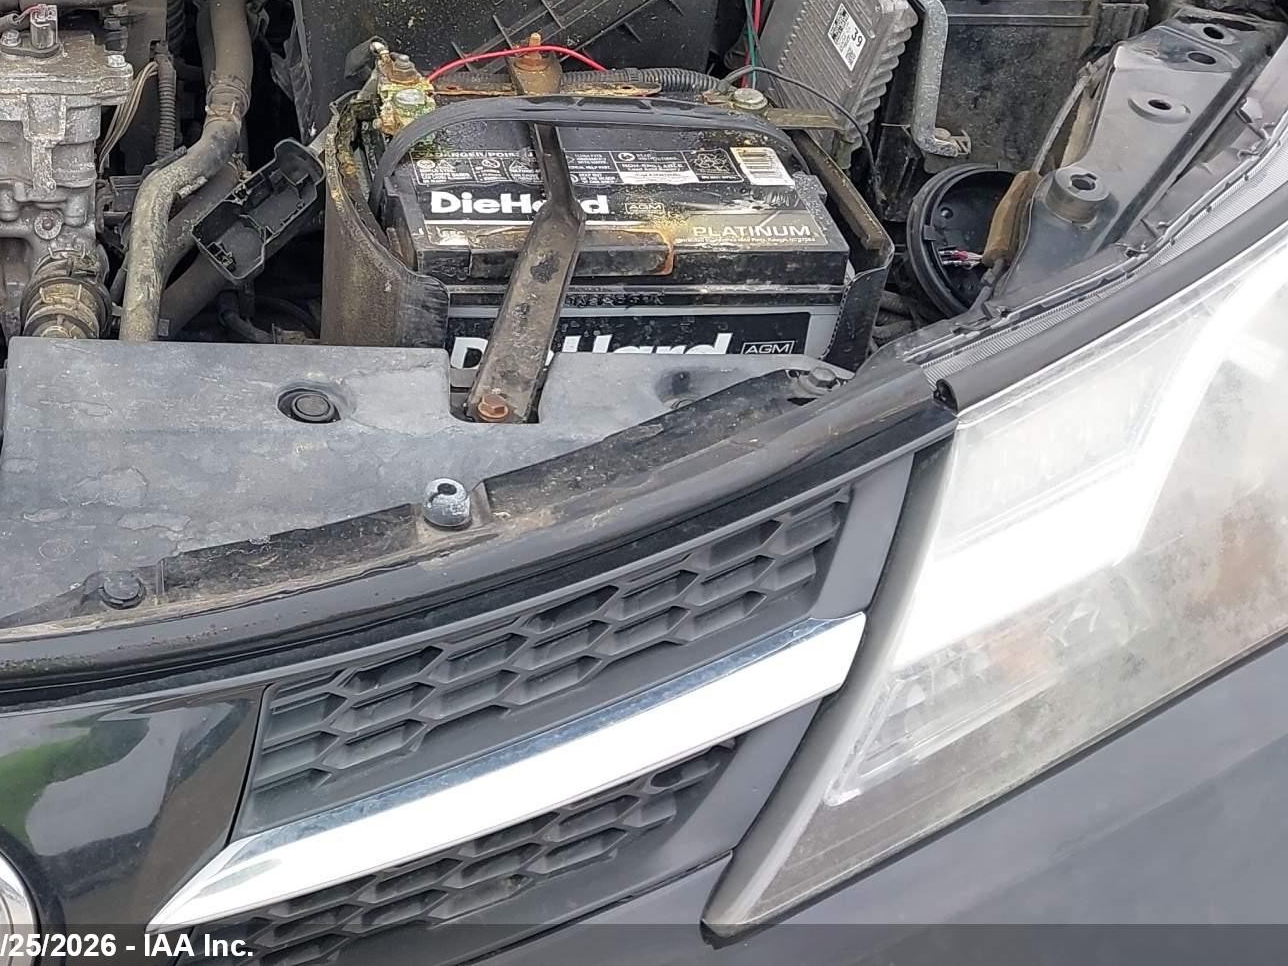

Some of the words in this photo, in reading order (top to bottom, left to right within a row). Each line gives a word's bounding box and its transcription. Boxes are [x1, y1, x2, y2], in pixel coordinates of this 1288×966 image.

[430, 190, 610, 215] DieHd
[628, 203, 663, 212] AGM
[693, 225, 811, 237] PLATINUM
[745, 342, 790, 354] AGM
